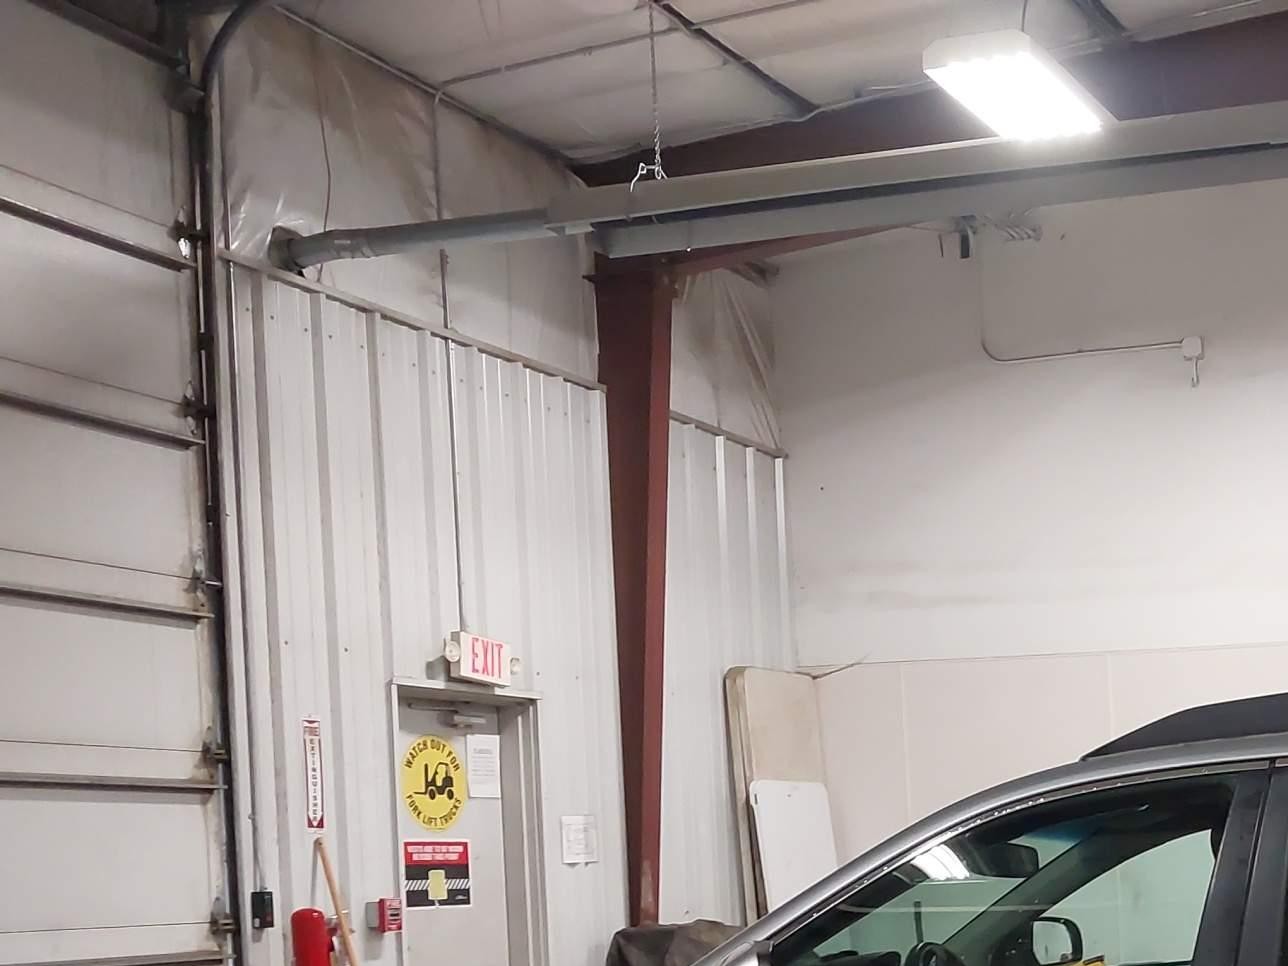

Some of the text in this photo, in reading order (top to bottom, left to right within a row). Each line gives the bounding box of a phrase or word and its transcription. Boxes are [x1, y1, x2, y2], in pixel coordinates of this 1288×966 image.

[471, 637, 504, 679] EXIT
[404, 739, 429, 769] WATCH
[430, 739, 446, 754] OUT
[446, 751, 461, 772] FOR
[405, 794, 462, 827] FORK LIFT TRUCKS
